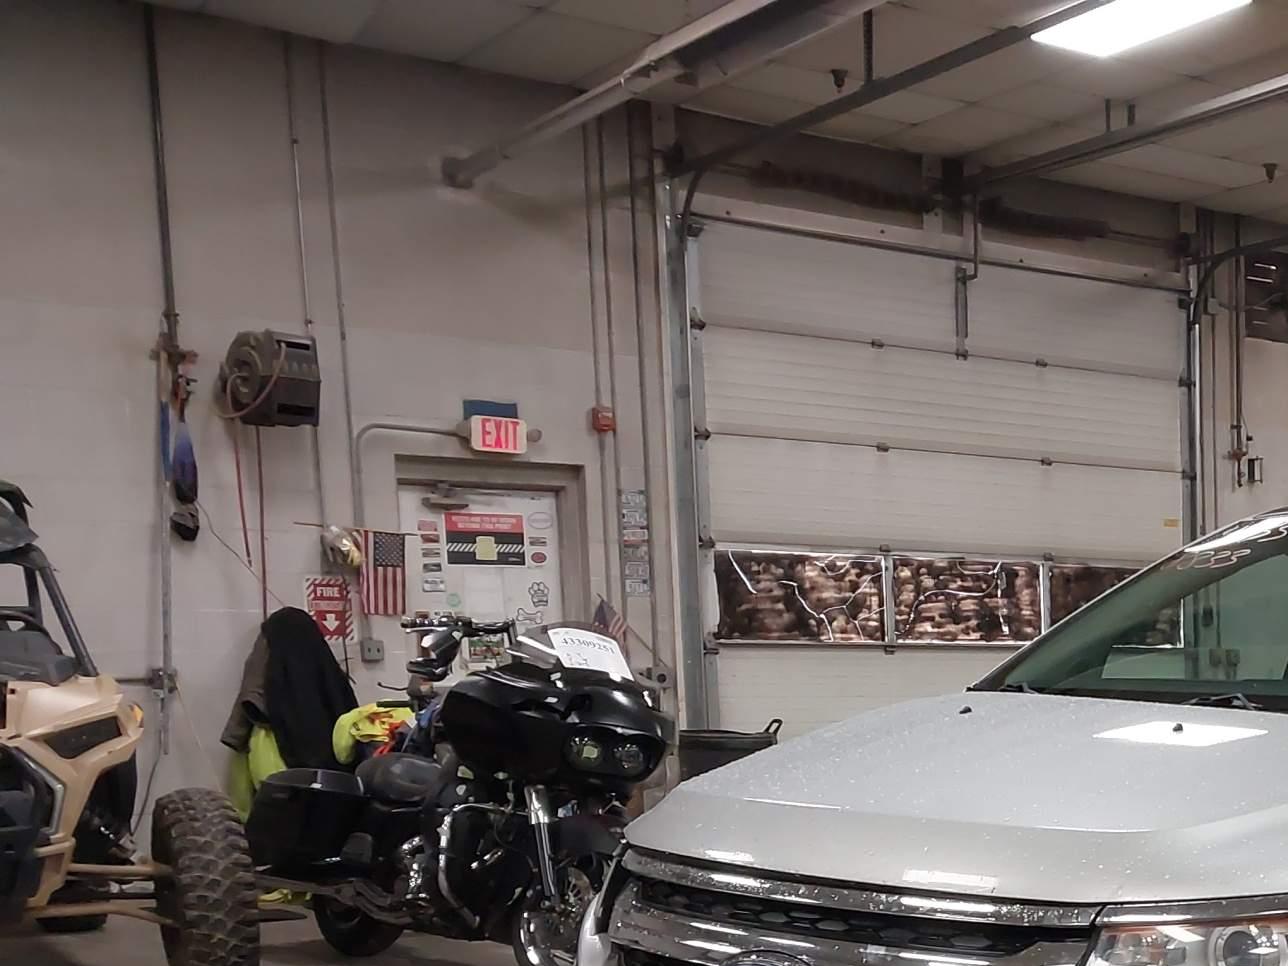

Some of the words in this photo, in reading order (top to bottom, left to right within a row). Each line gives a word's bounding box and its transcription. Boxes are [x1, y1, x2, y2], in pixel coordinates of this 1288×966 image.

[481, 418, 520, 450] EXIT
[316, 587, 341, 597] FIRE
[561, 637, 616, 654] 43309251
